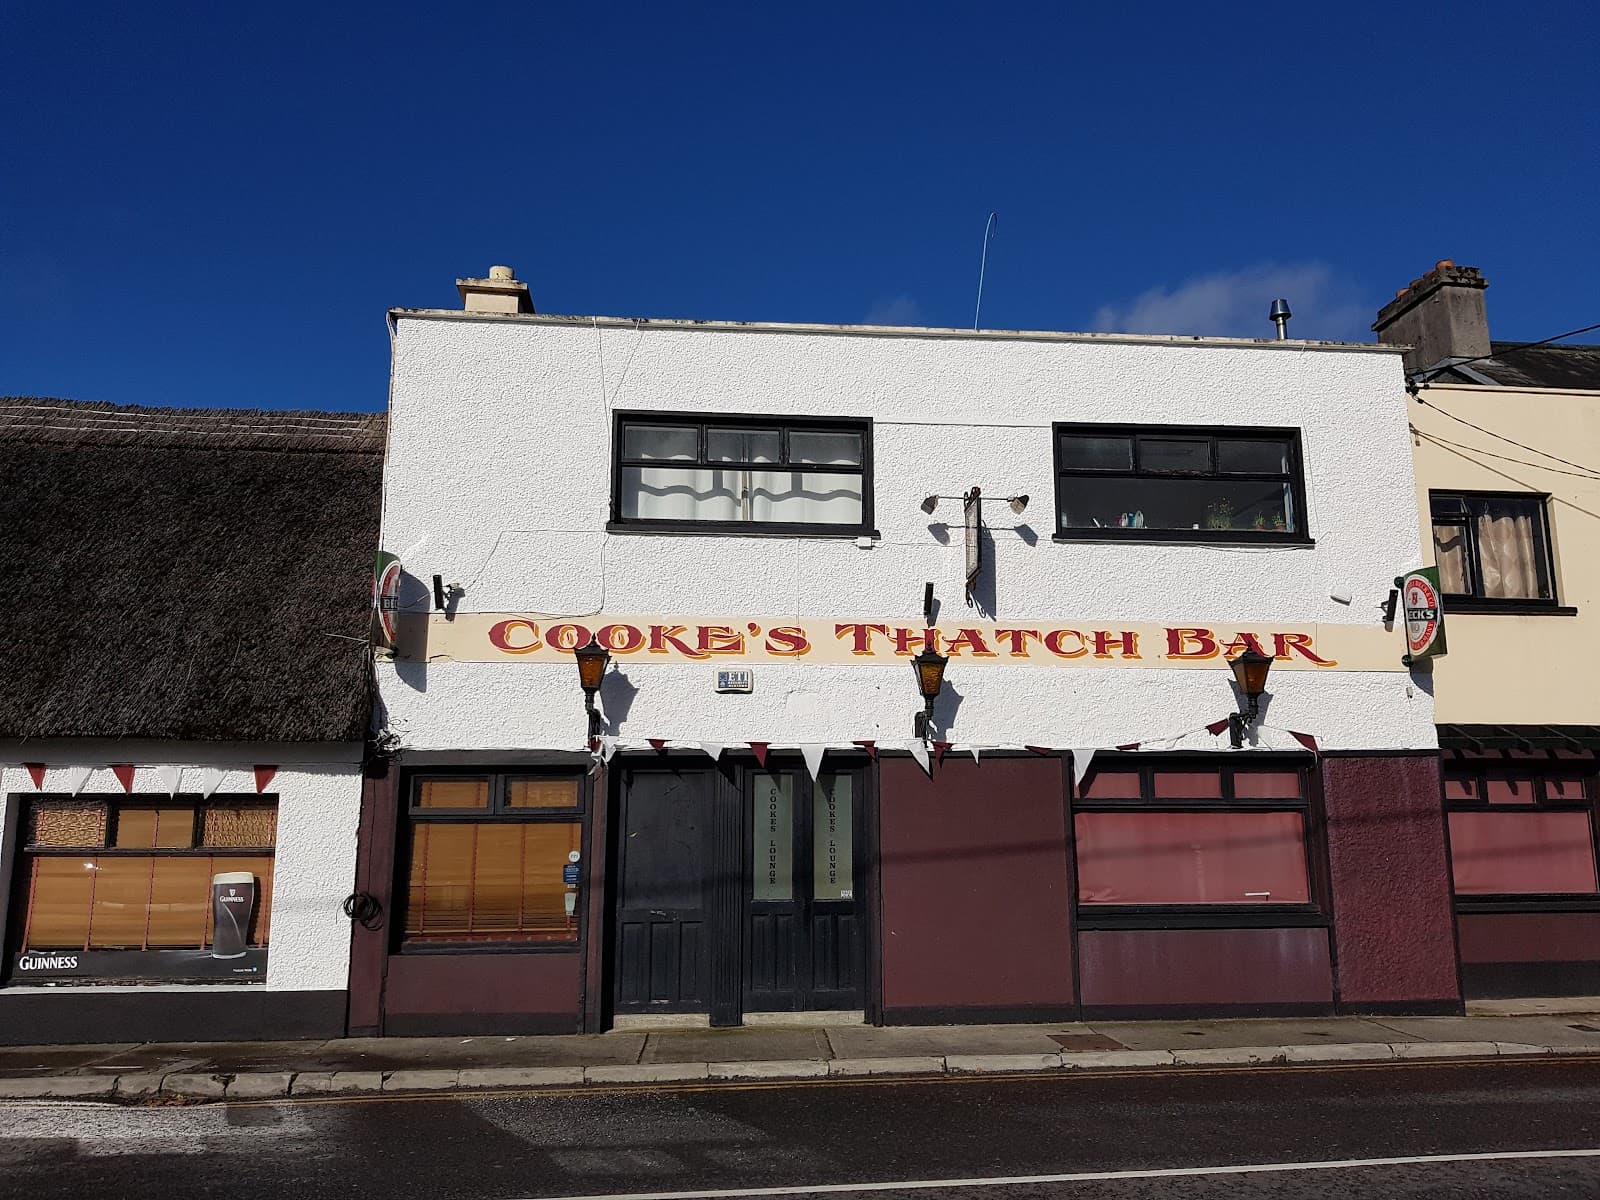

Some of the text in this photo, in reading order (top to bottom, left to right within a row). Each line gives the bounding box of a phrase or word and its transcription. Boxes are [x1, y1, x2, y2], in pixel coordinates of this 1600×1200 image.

[488, 619, 1338, 667] COOKE'S THATCH BAR
[19, 956, 78, 970] GUINNESS
